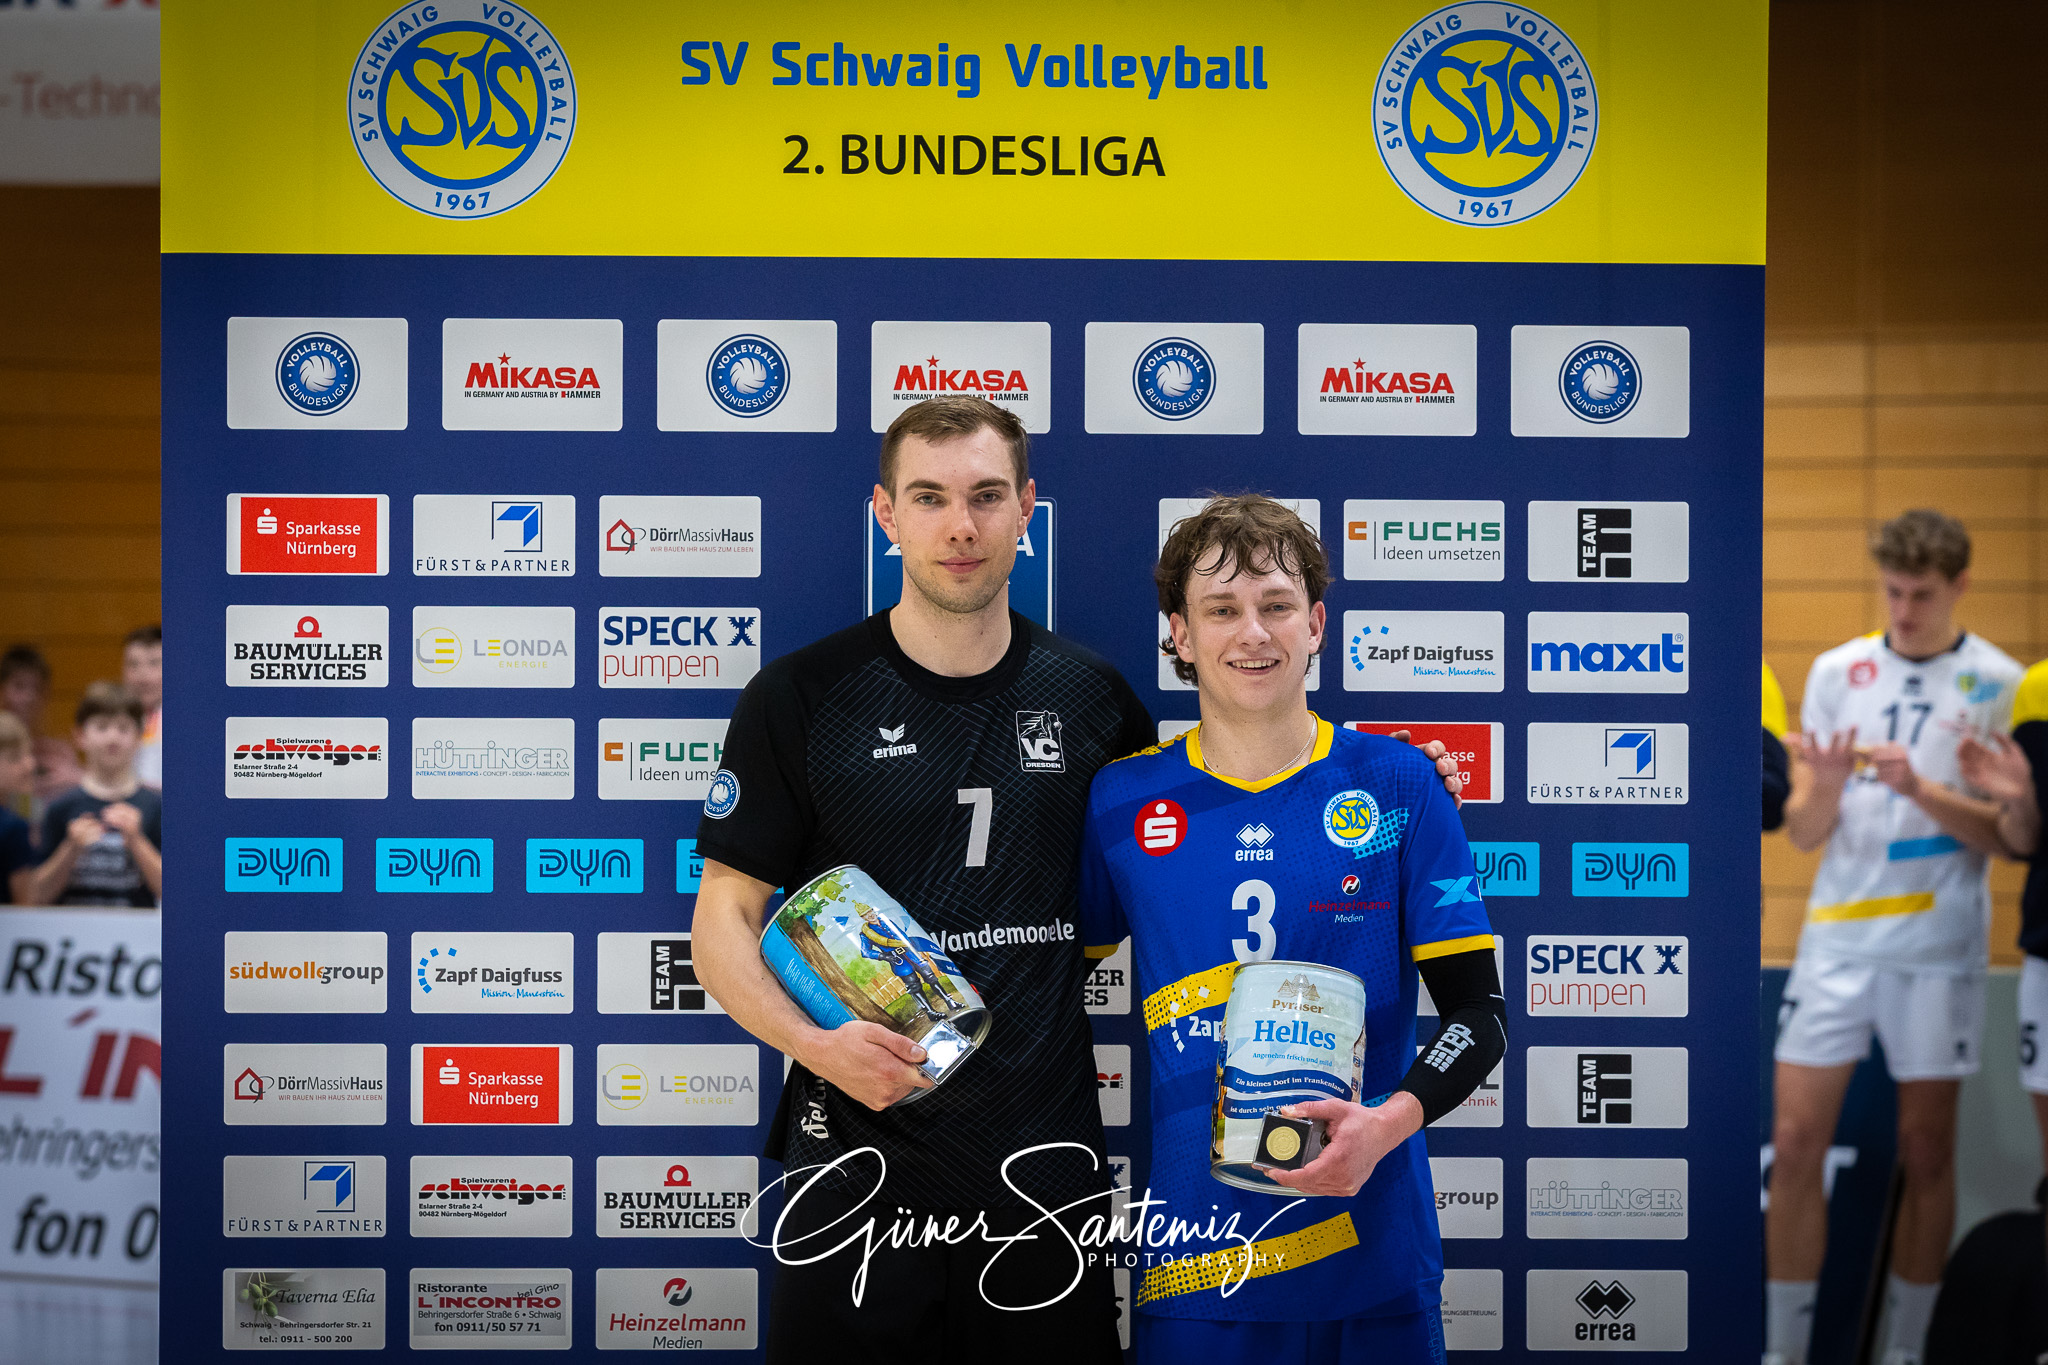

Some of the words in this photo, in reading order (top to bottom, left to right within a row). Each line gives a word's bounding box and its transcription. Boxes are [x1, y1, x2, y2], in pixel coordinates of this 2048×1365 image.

[358, 5, 439, 103] SCHWAIG
[1383, 14, 1462, 109] SCHWAIG
[481, 2, 566, 143] VOLLEYBALL
[682, 41, 749, 85] SV
[772, 42, 980, 98] Schwaig
[1005, 44, 1268, 100] Volleyball
[1505, 11, 1588, 151] VOLLEYBALL
[362, 112, 379, 142] SV
[1383, 119, 1402, 150] SV
[783, 135, 824, 174] 2.
[842, 134, 1165, 176] BUNDESLIGA
[434, 191, 491, 211] 1967
[1457, 198, 1514, 218] 1967
[287, 342, 348, 368] VOLLEYBALL
[717, 344, 778, 370] VOLLEYBALL
[1143, 347, 1204, 373] VOLLEYBALL
[1569, 351, 1630, 377] VOLLEYBALL
[288, 383, 348, 406] BUNDESLIGA
[718, 384, 778, 408] BUNDESLIGA
[1145, 388, 1205, 411] BUNDESLIGA
[1571, 391, 1630, 414] BUNDESLIGA
[286, 521, 360, 537] Sparkasse
[650, 528, 753, 542] DörrMassivHaus
[1384, 522, 1500, 541] FUCHS
[287, 541, 356, 558] Nürnberg
[1384, 546, 1422, 559] Ideen
[1429, 548, 1500, 560] umsetzen
[1583, 514, 1596, 571] TEAM
[417, 557, 470, 571] FÜRST
[492, 560, 569, 571] PARTNER
[604, 616, 718, 646] SPECK
[234, 643, 382, 660] BAUMÜLLER
[474, 640, 567, 656] LEONDA
[1368, 646, 1409, 663] Zapf
[1414, 646, 1493, 664] Daigfuss
[251, 663, 366, 680] SERVICES
[604, 655, 718, 684] pumpen
[1881, 702, 1934, 747] 17
[234, 739, 380, 766] schweiger
[416, 740, 569, 769] HÜTTINGER
[873, 743, 917, 759] erima
[1021, 738, 1060, 761] VC
[640, 767, 679, 780] Ideen
[1025, 761, 1061, 769] DRESDEN
[1531, 784, 1584, 797] FÜRST
[1605, 787, 1682, 798] PARTNER
[957, 787, 993, 868] 7
[239, 848, 329, 885] DYN
[389, 849, 480, 886] DYN
[540, 849, 630, 886] DYN
[1586, 853, 1675, 890] DYN
[1309, 899, 1391, 912] Heinzelmann
[1231, 879, 1276, 964] 3
[1334, 913, 1364, 923] Medien
[5, 938, 161, 998] Risto
[1531, 944, 1645, 974] SPECK
[436, 968, 477, 985] Zapf
[482, 968, 562, 986] Daigfuss
[656, 946, 669, 1004] TEAM
[1272, 998, 1324, 1014] Pyraser
[1531, 984, 1645, 1012] pumpen
[1253, 1020, 1336, 1050] Helles
[1306, 1056, 1318, 1064] und
[279, 1076, 382, 1090] DörrMassivHaus
[469, 1072, 543, 1088] Sparkasse
[661, 1076, 754, 1092] LEONDA
[1235, 1077, 1245, 1086] Ein
[1246, 1079, 1272, 1088] kleines
[1273, 1077, 1291, 1086] Dorf
[1304, 1076, 1345, 1094] Frankenland
[1583, 1060, 1596, 1117] TEAM
[470, 1091, 538, 1108] Nürnberg
[419, 1178, 565, 1205] schweiger
[604, 1192, 751, 1210] BAUMÜLLER
[1530, 1181, 1683, 1210] HÜTTINGER
[12, 1193, 107, 1258] fon
[229, 1217, 283, 1231] FÜRST
[304, 1220, 382, 1231] PARTNER
[621, 1212, 735, 1228] SERVICES
[276, 1288, 338, 1305] Taverna
[342, 1288, 375, 1305] Elia
[417, 1283, 488, 1293] Ristorante
[517, 1290, 533, 1300] bei
[535, 1283, 560, 1295] Gino
[240, 1321, 272, 1330] Schwaig
[279, 1321, 344, 1330] Behringersdorfer
[346, 1321, 360, 1329] Str.
[362, 1321, 372, 1329] 21
[418, 1310, 484, 1320] Behringersdorfer
[486, 1310, 513, 1319] Straße
[514, 1310, 520, 1319] 6
[528, 1310, 562, 1321] Schwaig
[610, 1313, 745, 1331] Heinzelmann
[434, 1322, 454, 1332] fon
[456, 1322, 506, 1334] 0911/50
[509, 1322, 523, 1332] 57
[527, 1322, 542, 1332] 71
[259, 1335, 278, 1344] tel.:
[280, 1335, 304, 1344] 0911
[314, 1335, 332, 1344] 500
[335, 1335, 353, 1344] 200
[653, 1336, 703, 1349] Medien
